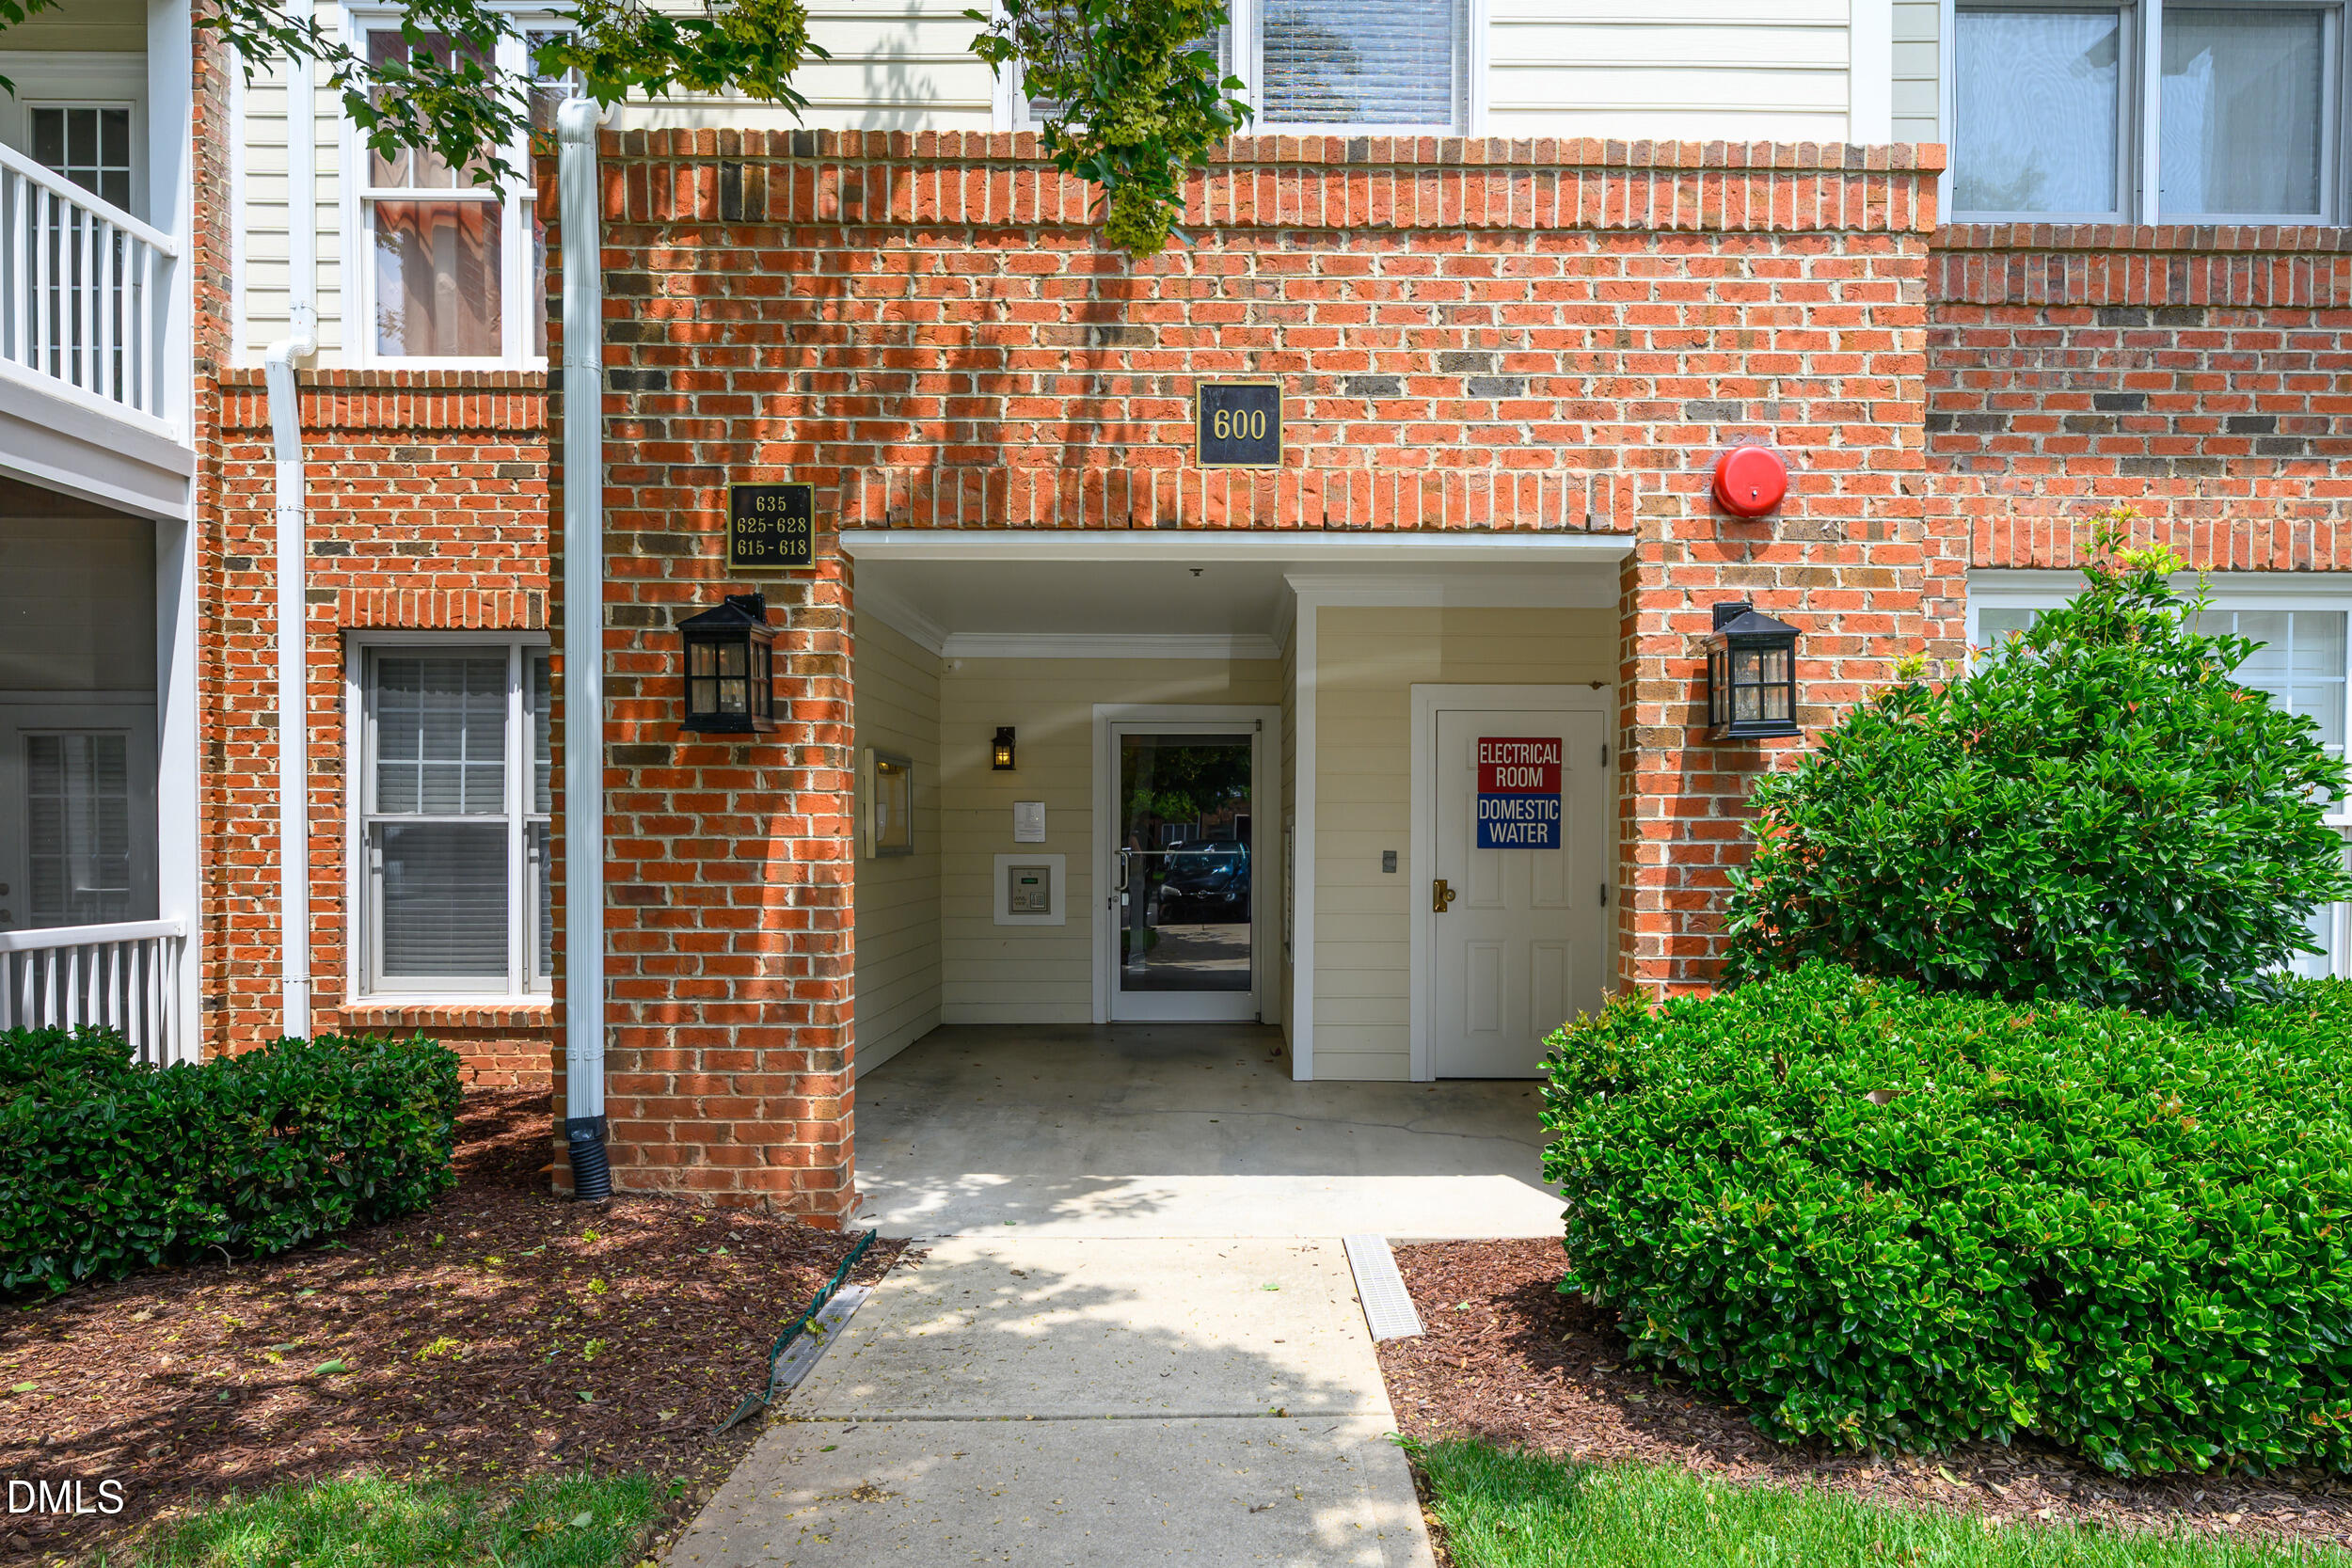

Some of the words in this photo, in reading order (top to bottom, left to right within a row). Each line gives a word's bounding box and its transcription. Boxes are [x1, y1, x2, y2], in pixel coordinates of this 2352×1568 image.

[1214, 409, 1266, 439] 600
[756, 496, 787, 512] 635
[737, 517, 806, 533] 625-628
[1480, 743, 1560, 764] ELECTRICAL
[1496, 767, 1543, 787] ROOM
[1479, 799, 1559, 820] DOMESTIC
[1489, 822, 1548, 843] WATER
